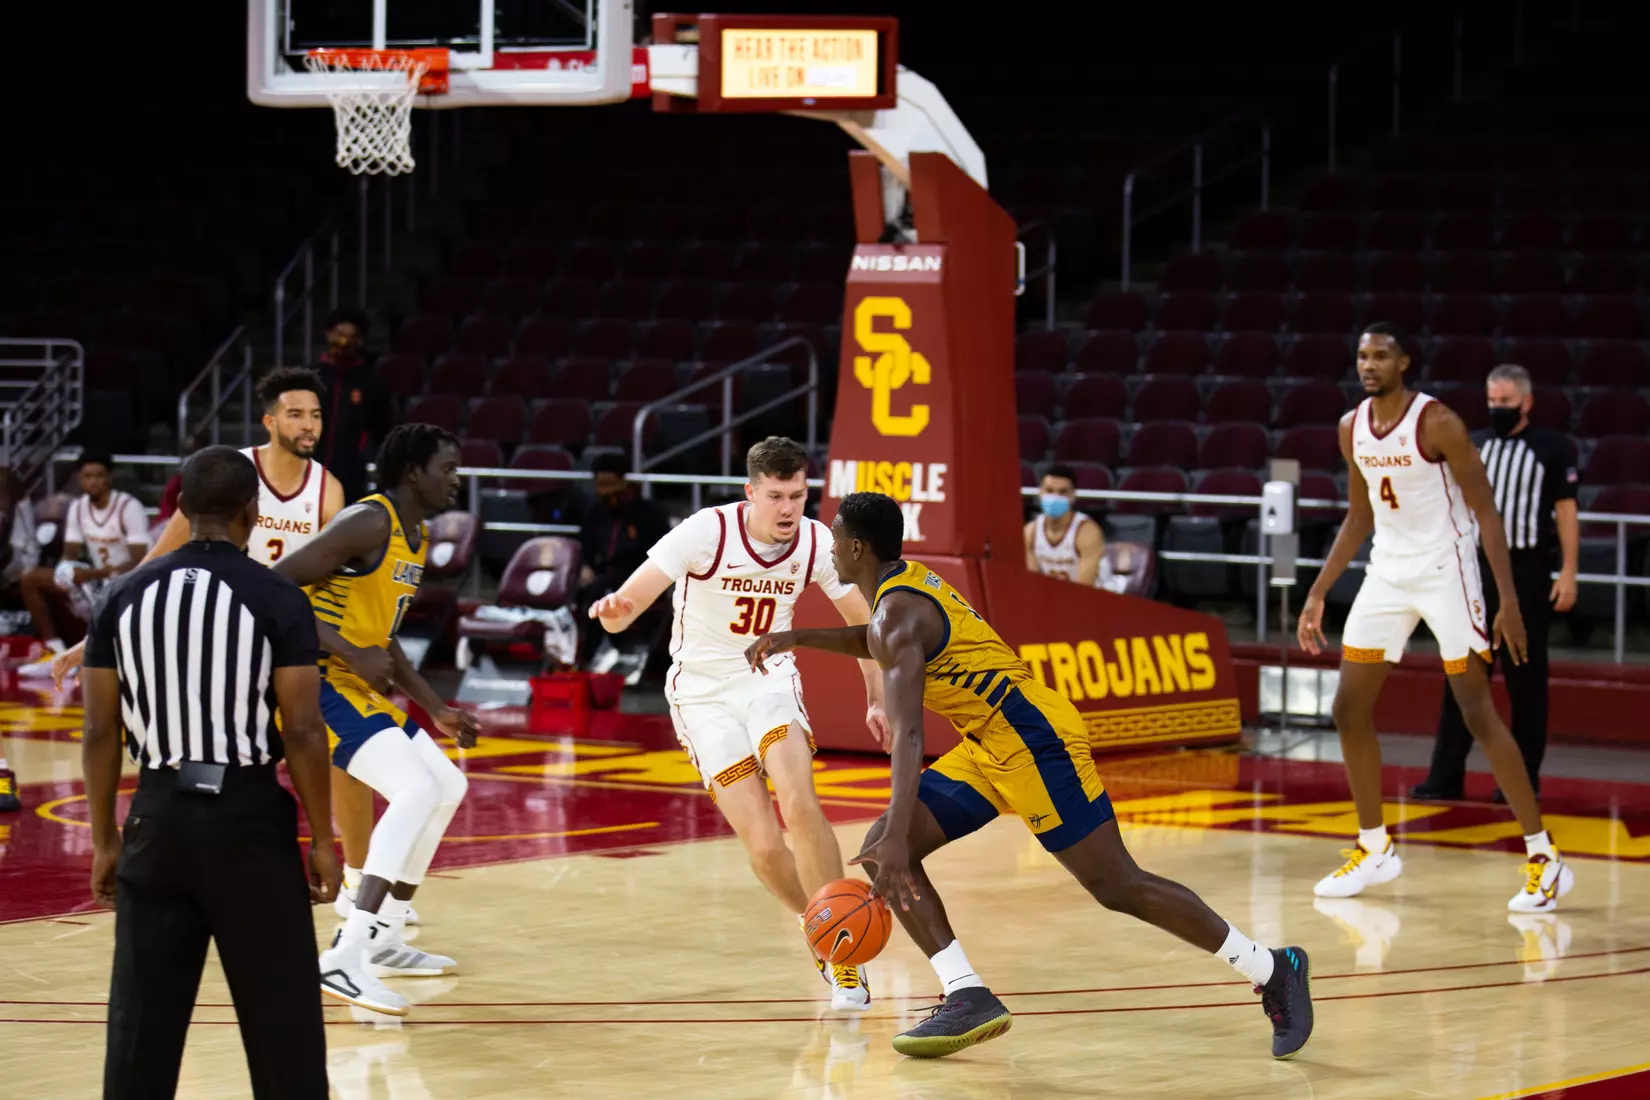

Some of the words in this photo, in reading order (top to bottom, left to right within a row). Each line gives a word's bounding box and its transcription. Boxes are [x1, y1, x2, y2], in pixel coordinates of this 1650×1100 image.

[734, 37, 773, 60] HEAR
[780, 37, 806, 60] THE
[813, 38, 864, 60] ACTION
[749, 66, 779, 88] LIVE
[786, 66, 804, 87] ON
[852, 254, 942, 272] NISSAN
[854, 296, 931, 437] SC
[1359, 455, 1412, 468] TROJANS
[828, 459, 948, 503] MUSCLE
[1379, 475, 1400, 510] 4
[256, 514, 312, 535] ROJANS
[721, 577, 796, 596] TROJANS
[729, 596, 777, 637] 30
[1019, 632, 1217, 702] TROJANS
